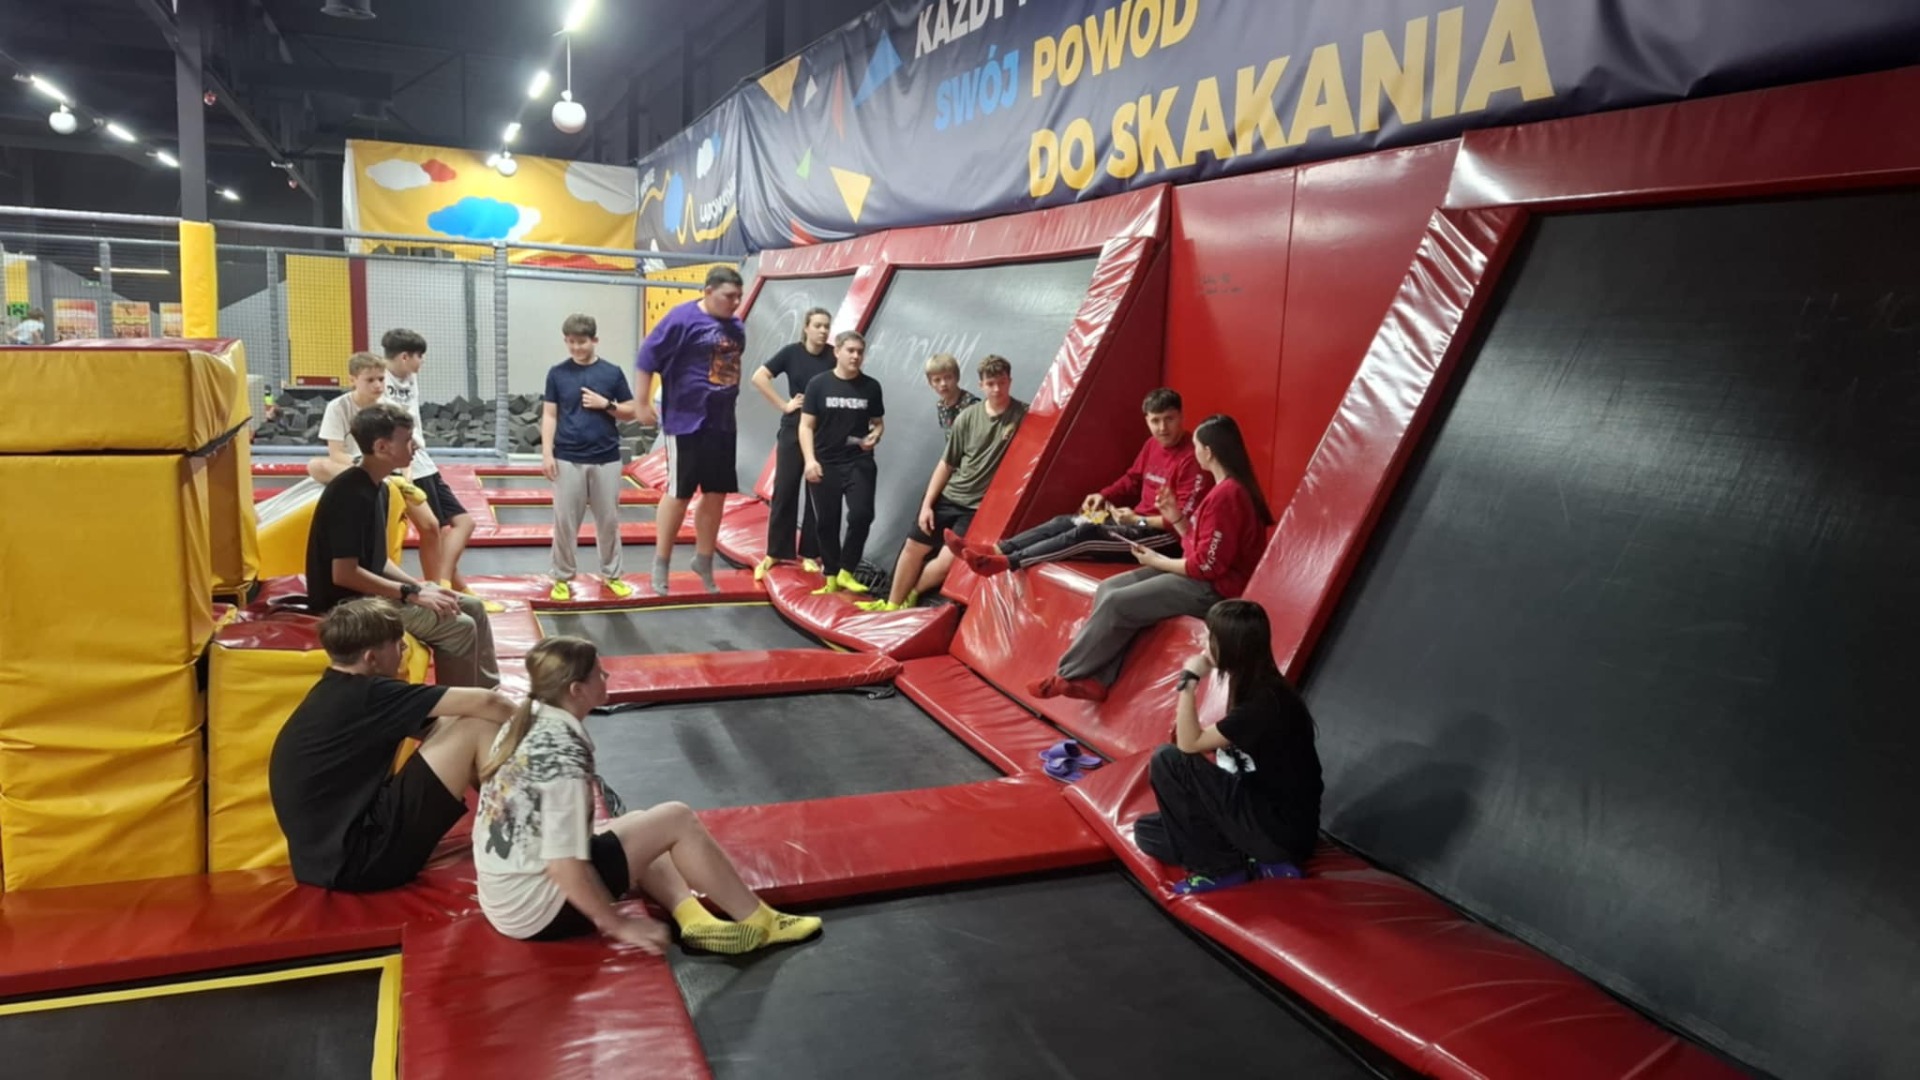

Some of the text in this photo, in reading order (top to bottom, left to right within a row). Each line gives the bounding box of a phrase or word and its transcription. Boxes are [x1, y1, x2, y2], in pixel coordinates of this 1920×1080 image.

[934, 44, 1019, 131] SWÓJ
[1029, 0, 1555, 197] DO SKAKANIA
